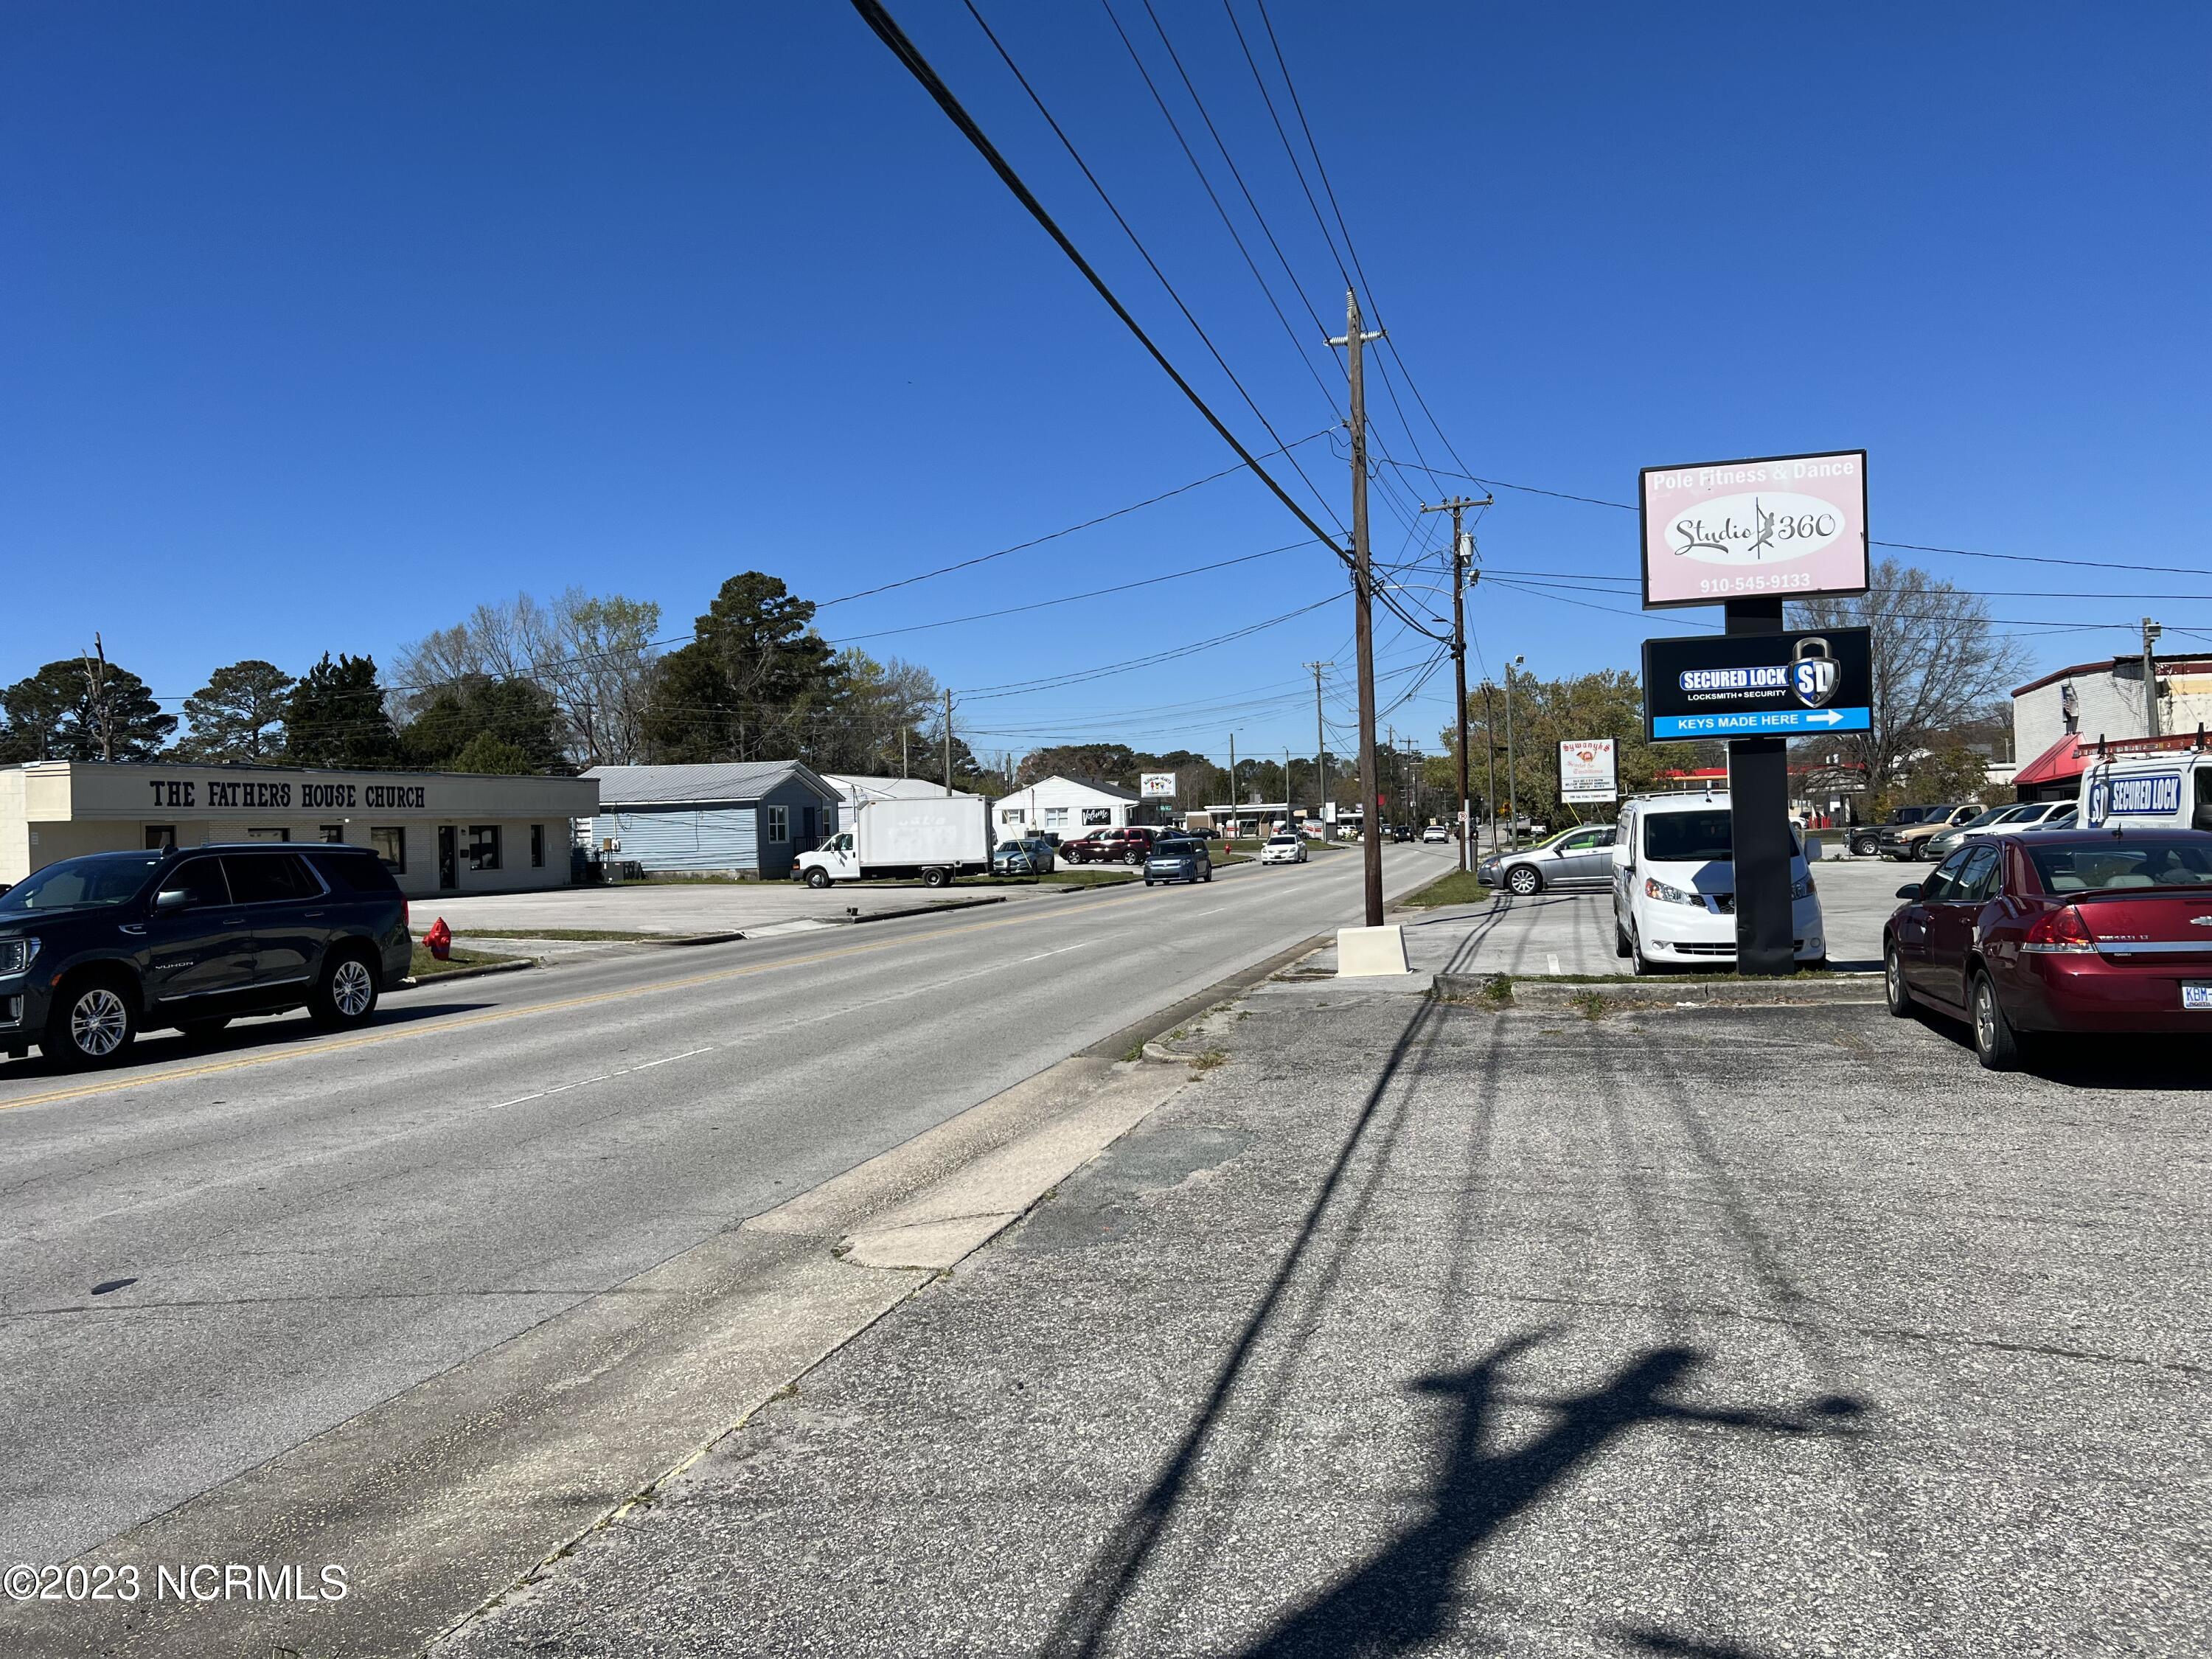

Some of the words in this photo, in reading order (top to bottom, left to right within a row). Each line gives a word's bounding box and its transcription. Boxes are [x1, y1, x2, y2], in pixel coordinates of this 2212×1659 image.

[1653, 473, 1693, 490] Pole
[1700, 467, 1766, 487] Fitness
[1773, 465, 1788, 480] &
[1794, 462, 1854, 479] Dance
[1674, 518, 1753, 555] Studio
[1778, 514, 1835, 540] 360
[1700, 573, 1811, 593] 910-545-9133
[1684, 669, 1747, 689] SECURED
[1750, 667, 1787, 686] LOCK
[1798, 664, 1828, 693] SL
[1688, 692, 1737, 701] LOCKSMITH
[1743, 689, 1787, 698] SECURITY
[1678, 718, 1714, 729] KEYS
[1718, 716, 1758, 728] MADE
[1761, 714, 1798, 726] HERE
[150, 781, 195, 807] THE
[208, 782, 291, 807] FATHER'S
[302, 784, 356, 807] HOUSE
[365, 785, 425, 808] CHURCH
[2112, 780, 2152, 810] SECURED
[2153, 779, 2179, 810] LOCK
[155, 961, 194, 970] YUKON
